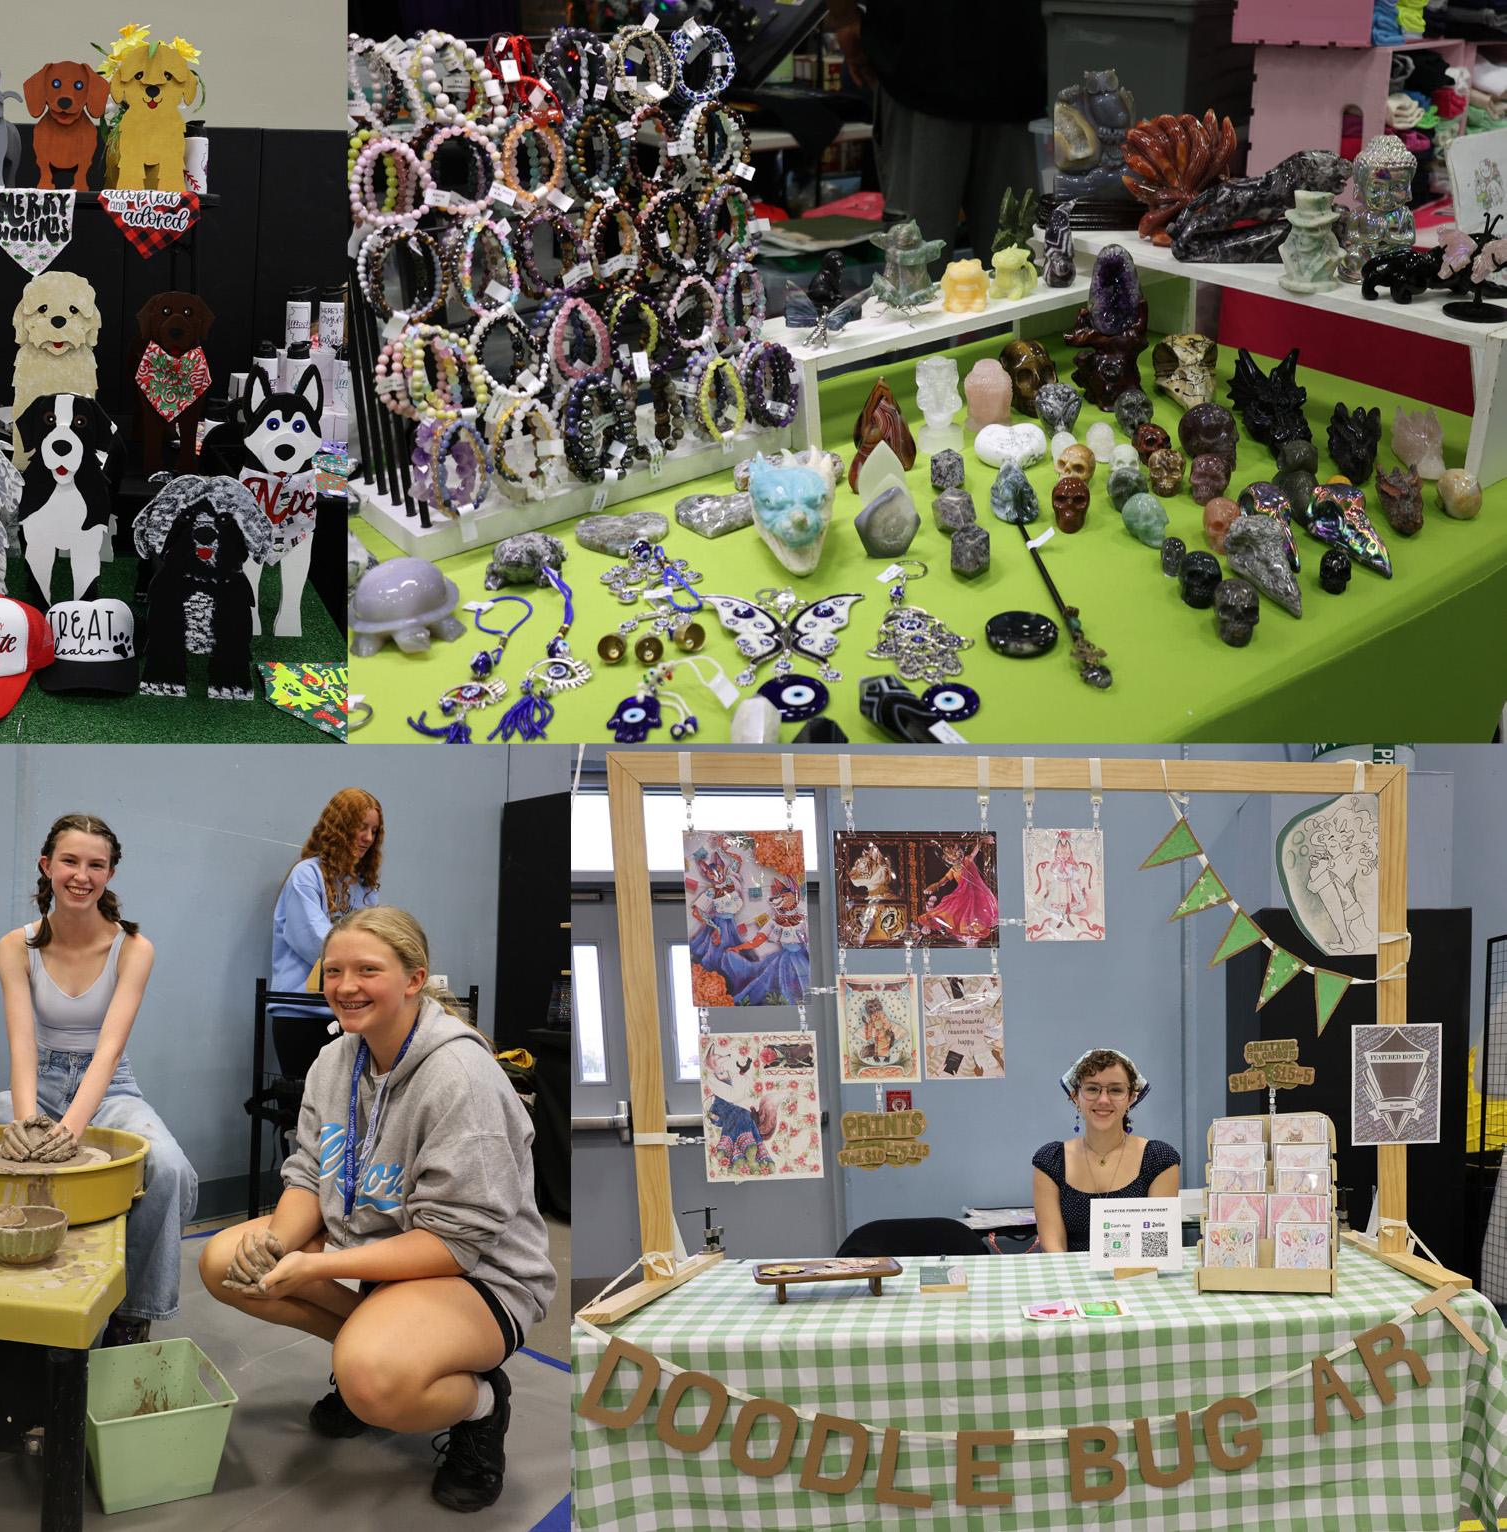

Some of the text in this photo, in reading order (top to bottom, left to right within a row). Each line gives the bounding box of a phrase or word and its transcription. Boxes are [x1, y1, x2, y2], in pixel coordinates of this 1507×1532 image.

[110, 201, 126, 211] AND
[124, 209, 188, 230] adored
[49, 609, 114, 641] TREAT
[843, 1112, 924, 1137] PRINTS
[345, 1152, 355, 1193] WARRIORS
[577, 1282, 1489, 1509] DOODLE BUG ART
